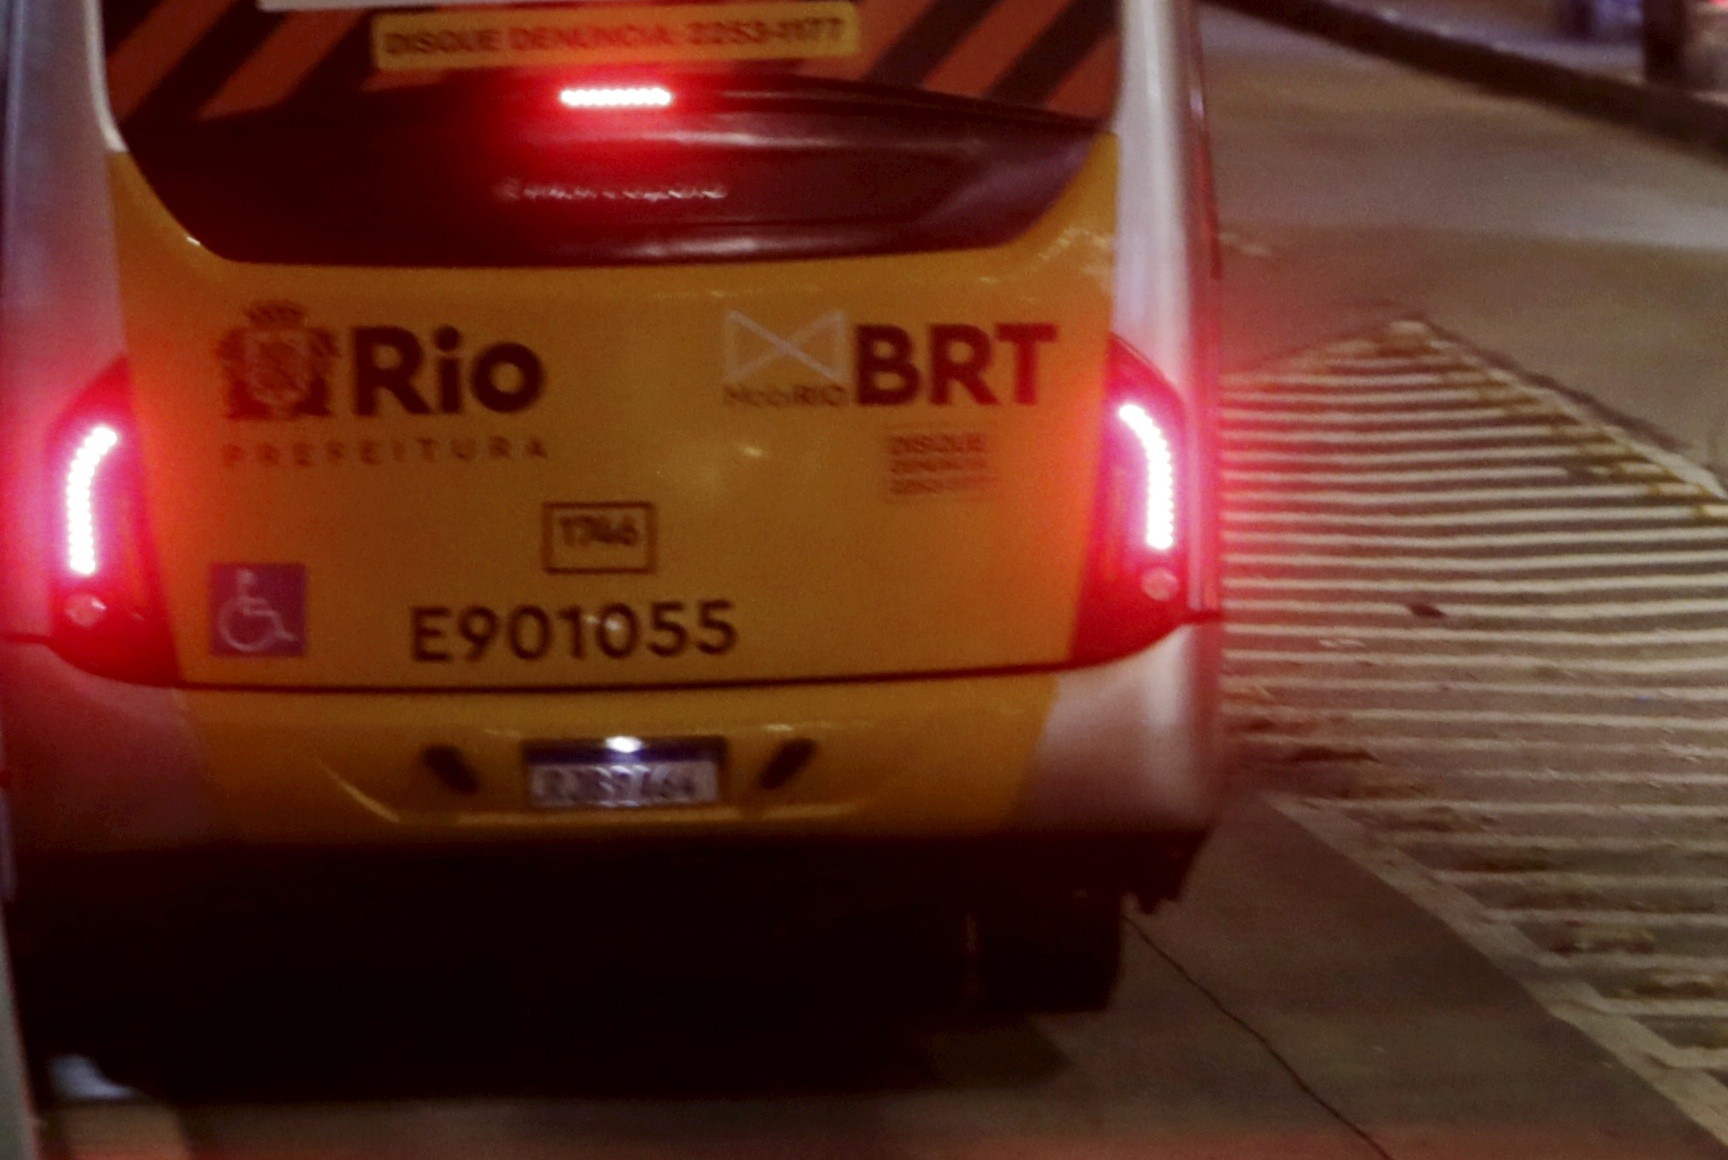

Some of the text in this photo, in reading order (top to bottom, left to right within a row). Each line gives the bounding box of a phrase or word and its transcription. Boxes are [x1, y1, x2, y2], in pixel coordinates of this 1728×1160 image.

[350, 324, 546, 417] Rio
[855, 321, 1059, 408] BRT
[222, 436, 549, 467] PREFEITURA
[559, 514, 640, 546] 1746
[410, 598, 736, 662] E901055
